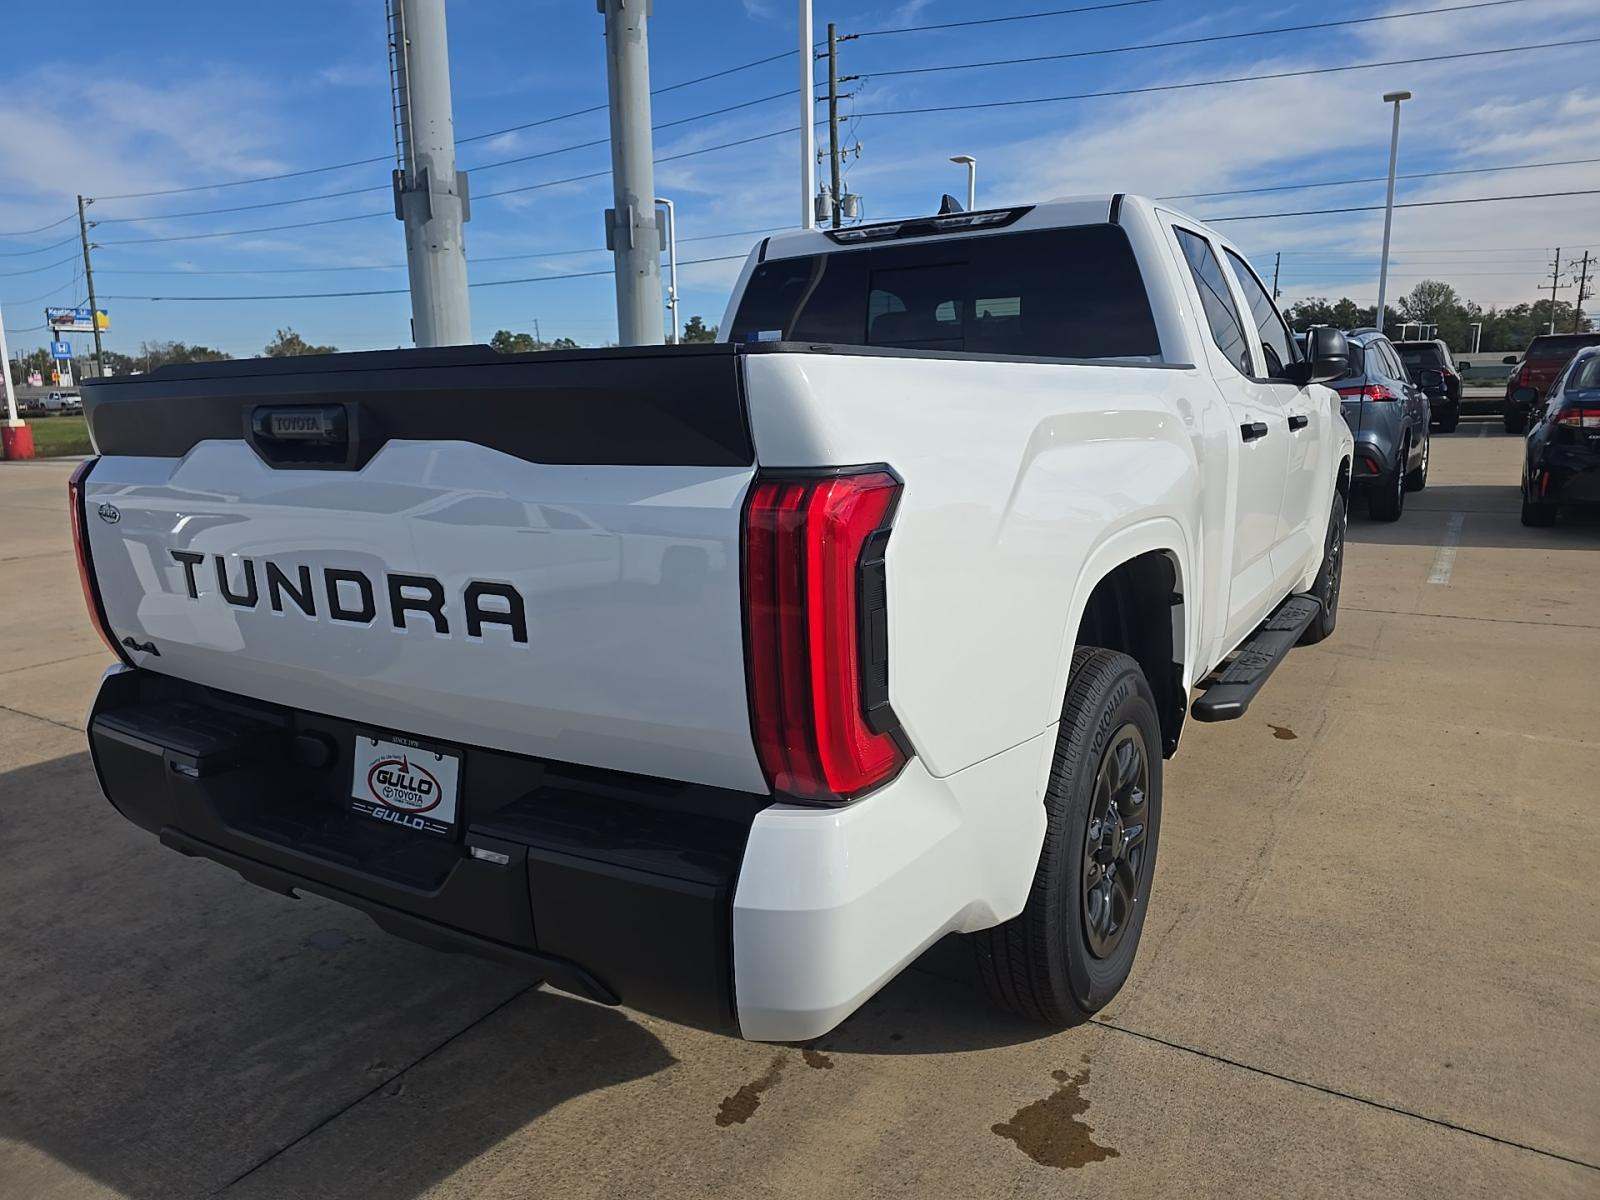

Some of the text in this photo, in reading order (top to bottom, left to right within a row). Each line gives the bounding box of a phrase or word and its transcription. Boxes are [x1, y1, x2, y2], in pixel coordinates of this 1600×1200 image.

[275, 416, 320, 432] TOYOTA
[170, 550, 529, 645] TUNDRA
[376, 769, 434, 796] GULLO
[393, 788, 423, 804] TOYOTA
[371, 807, 426, 831] GULLO
